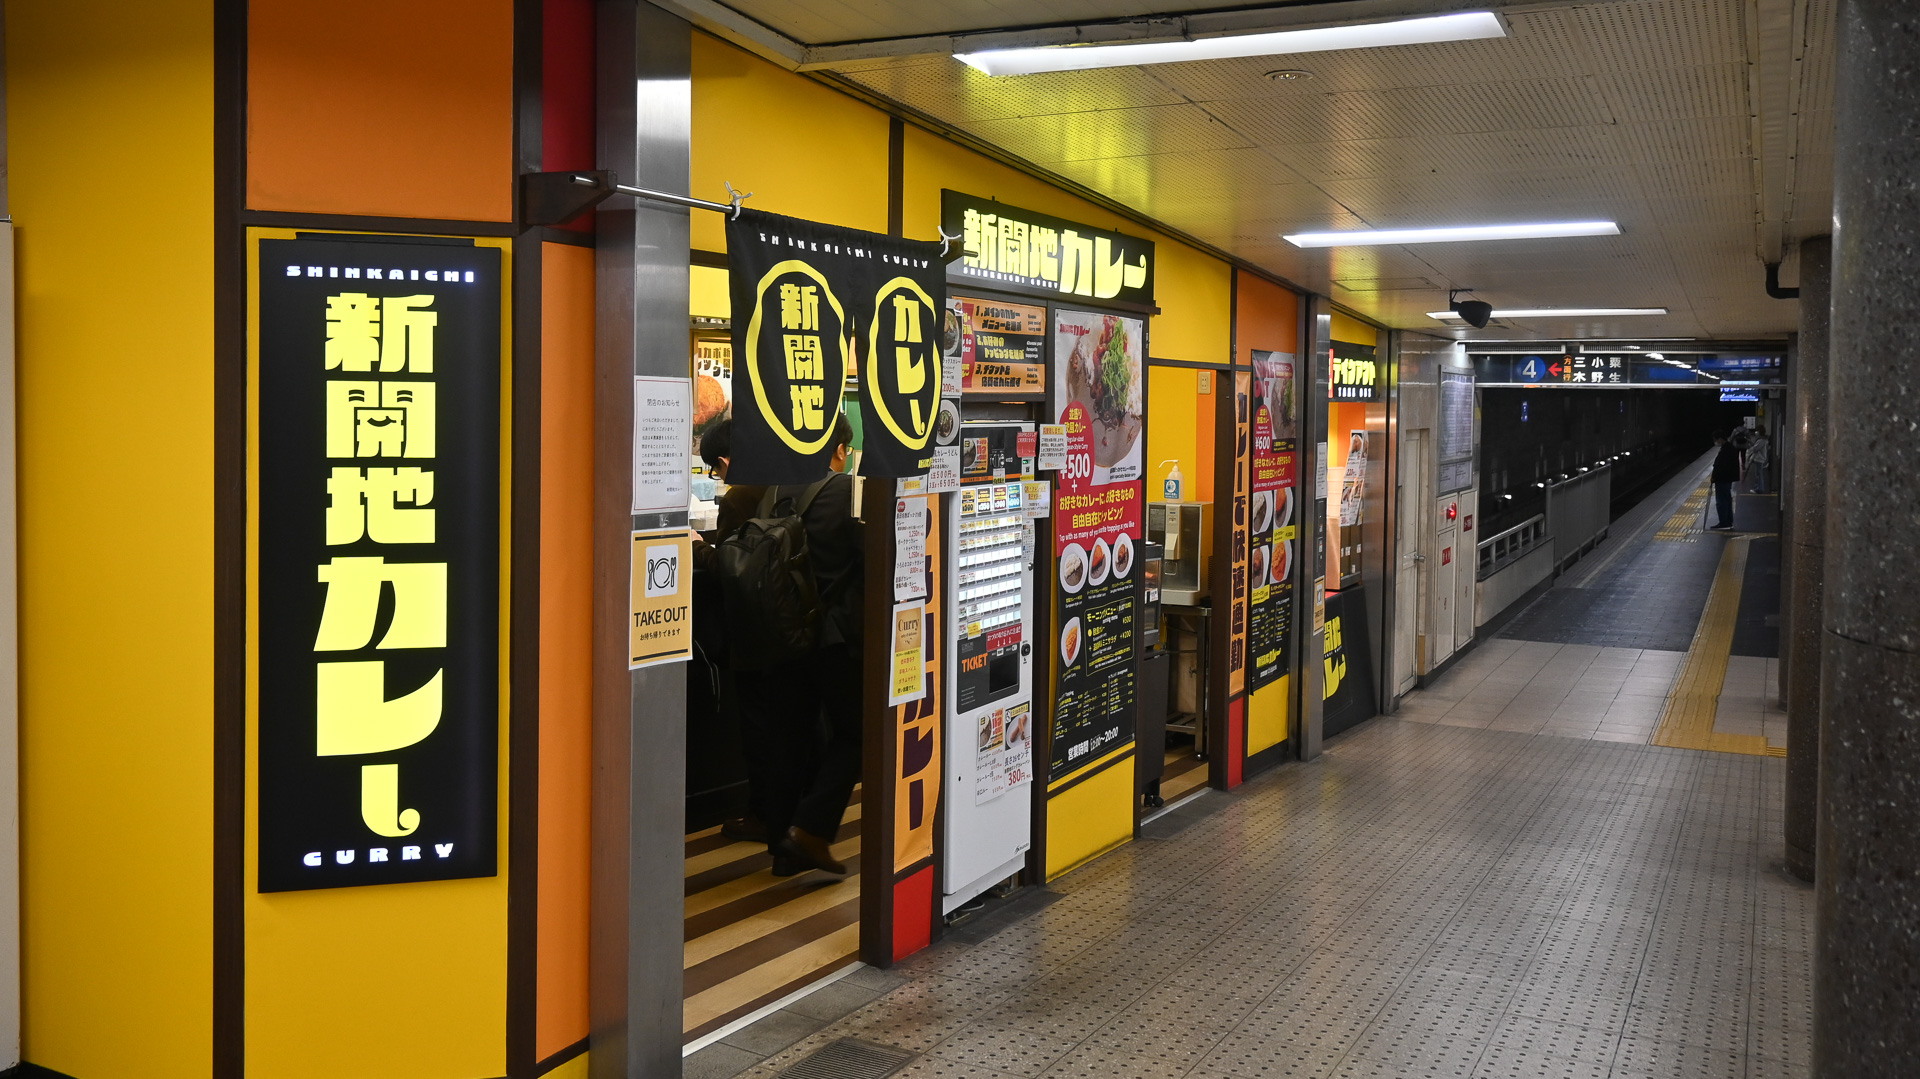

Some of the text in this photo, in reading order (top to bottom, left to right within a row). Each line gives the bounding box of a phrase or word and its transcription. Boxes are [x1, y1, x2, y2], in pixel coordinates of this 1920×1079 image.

[963, 208, 1147, 299] 新開地カレー
[285, 265, 476, 284] SHINKAICHI
[779, 282, 825, 431] 新開地
[892, 294, 927, 436] カレー
[1522, 359, 1537, 378] 4
[1572, 356, 1587, 382] 三木
[1591, 356, 1604, 383] 小野
[646, 398, 680, 407] 閉店のお知らせ
[1255, 437, 1271, 450] ¥600
[1065, 532, 1074, 541] with
[1078, 530, 1089, 540] many
[1089, 529, 1094, 537] of
[1230, 392, 1249, 674] カレーで快速通勤
[313, 291, 448, 838] 新開地カレー
[633, 606, 688, 628] TAKE OUT
[898, 618, 920, 633] Curry
[640, 627, 681, 641] お持ち帰りできます
[961, 652, 989, 673] TICKET
[1008, 768, 1026, 787] 380円
[303, 842, 455, 868] CURRY
